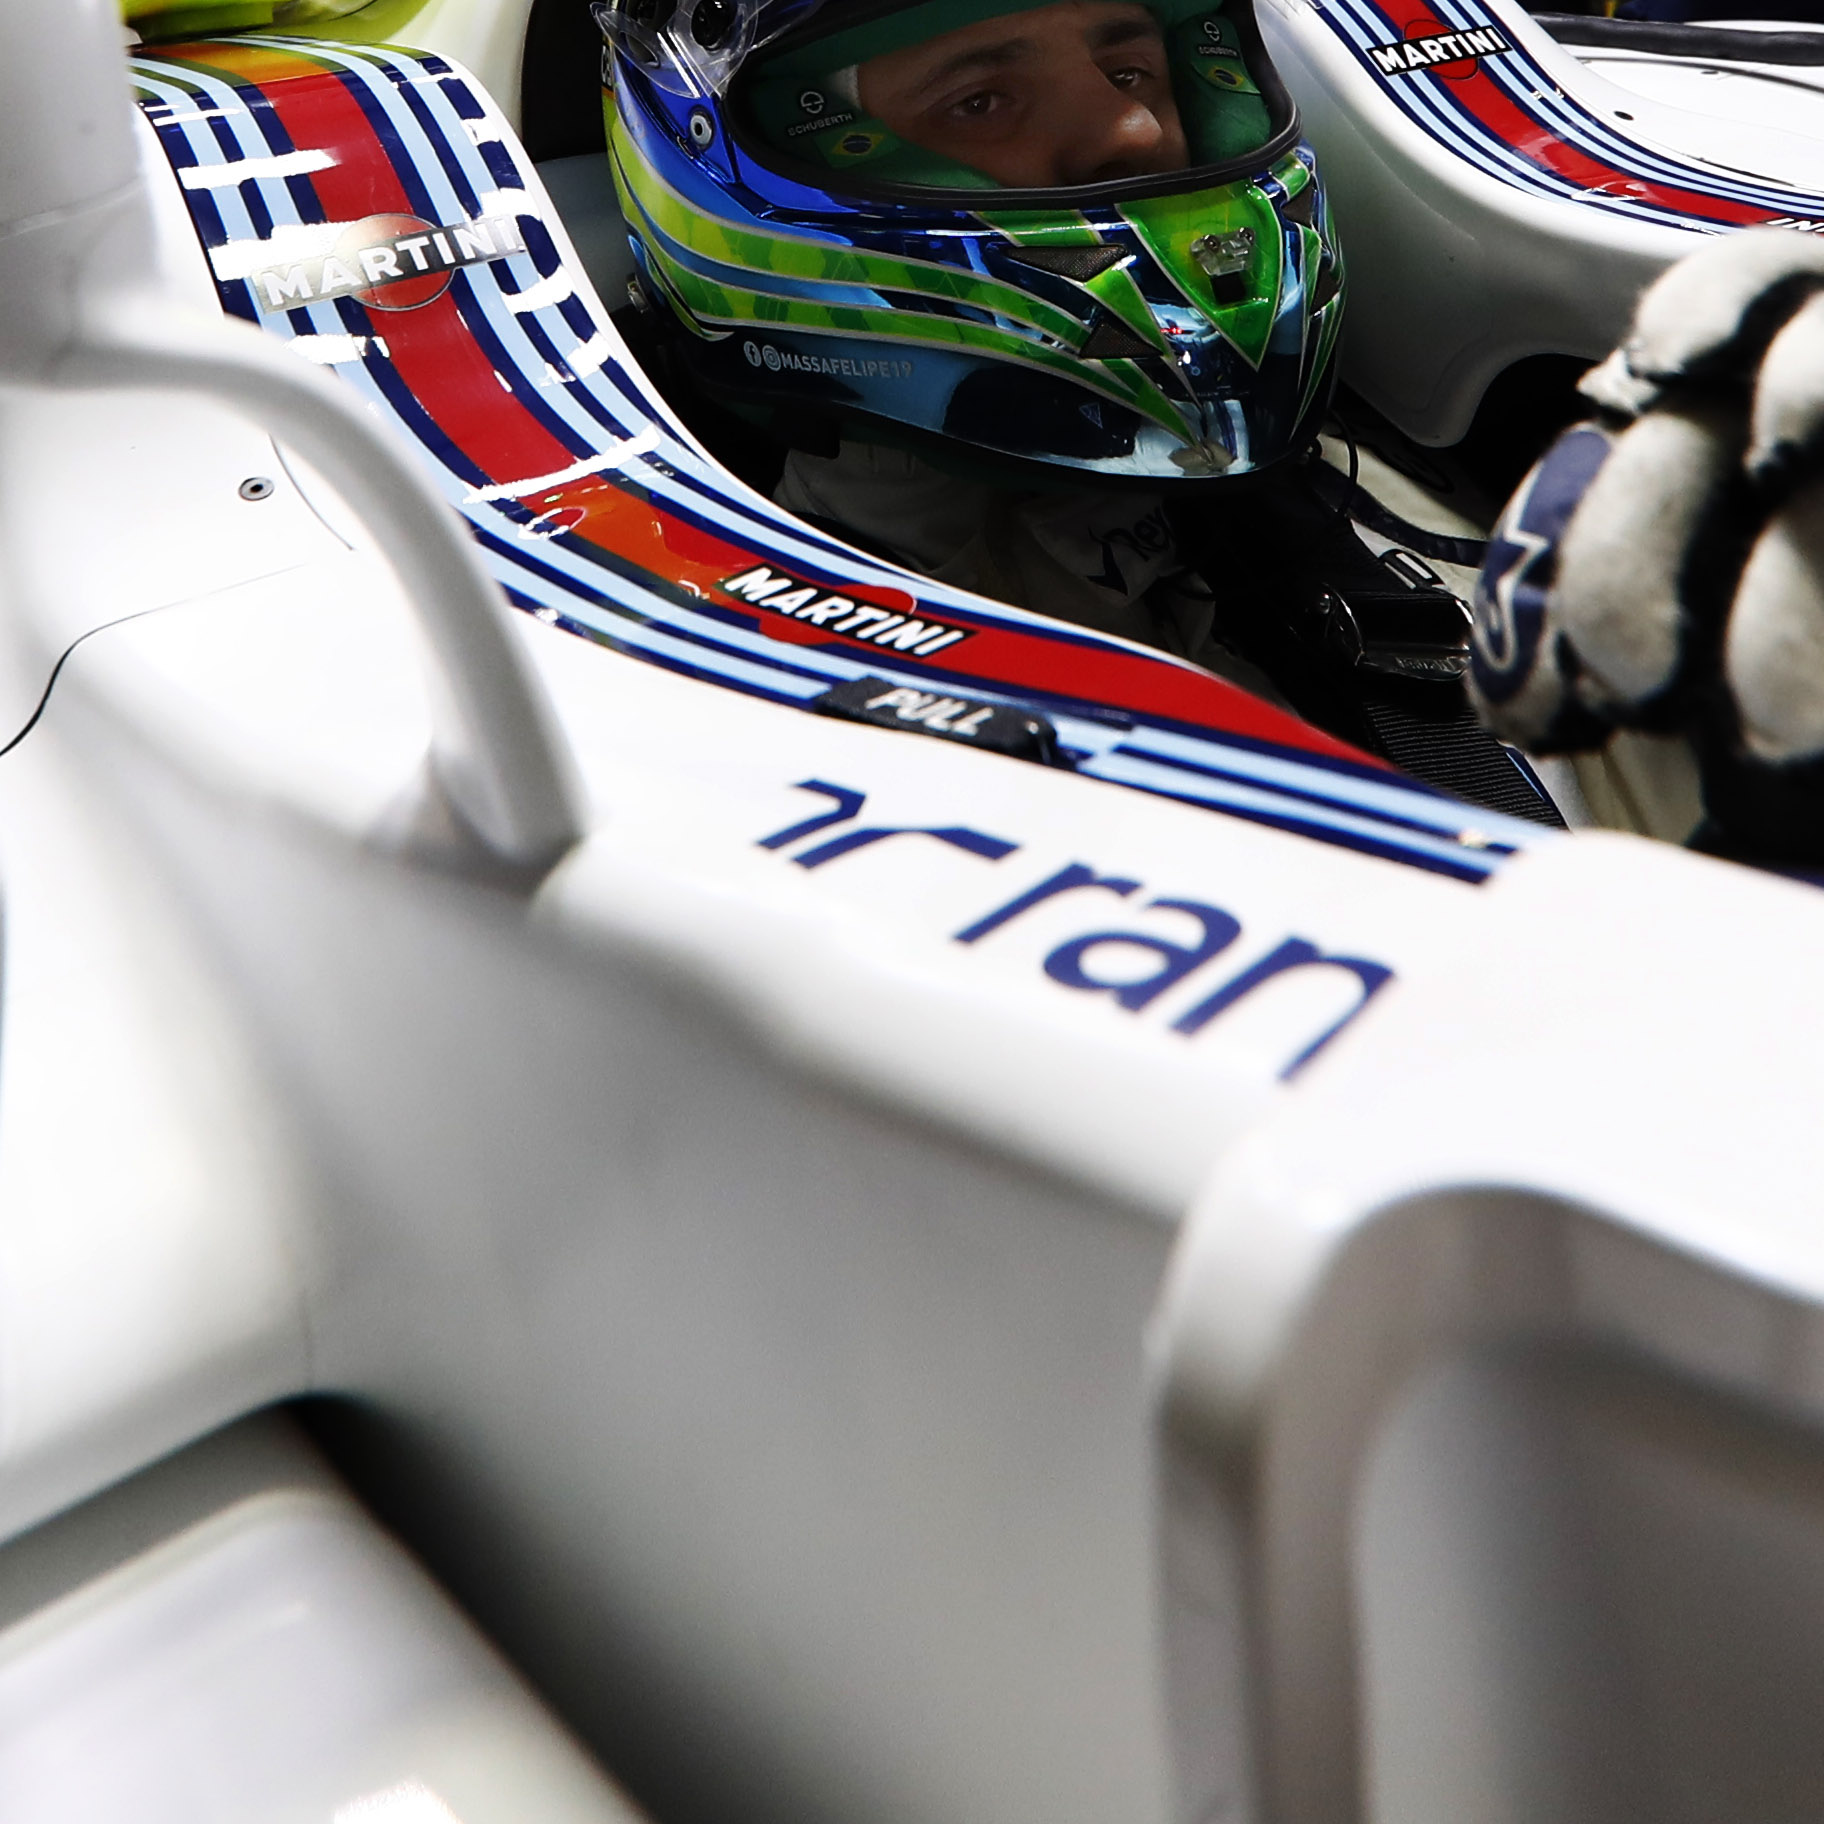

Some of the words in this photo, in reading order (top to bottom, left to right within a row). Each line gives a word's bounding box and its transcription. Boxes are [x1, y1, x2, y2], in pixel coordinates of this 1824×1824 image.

[1372, 28, 1506, 72] MARTINI
[787, 112, 853, 136] SCHUBERTH
[261, 216, 520, 307] MARTINI
[724, 566, 964, 656] MARTINI
[866, 687, 994, 736] PULL
